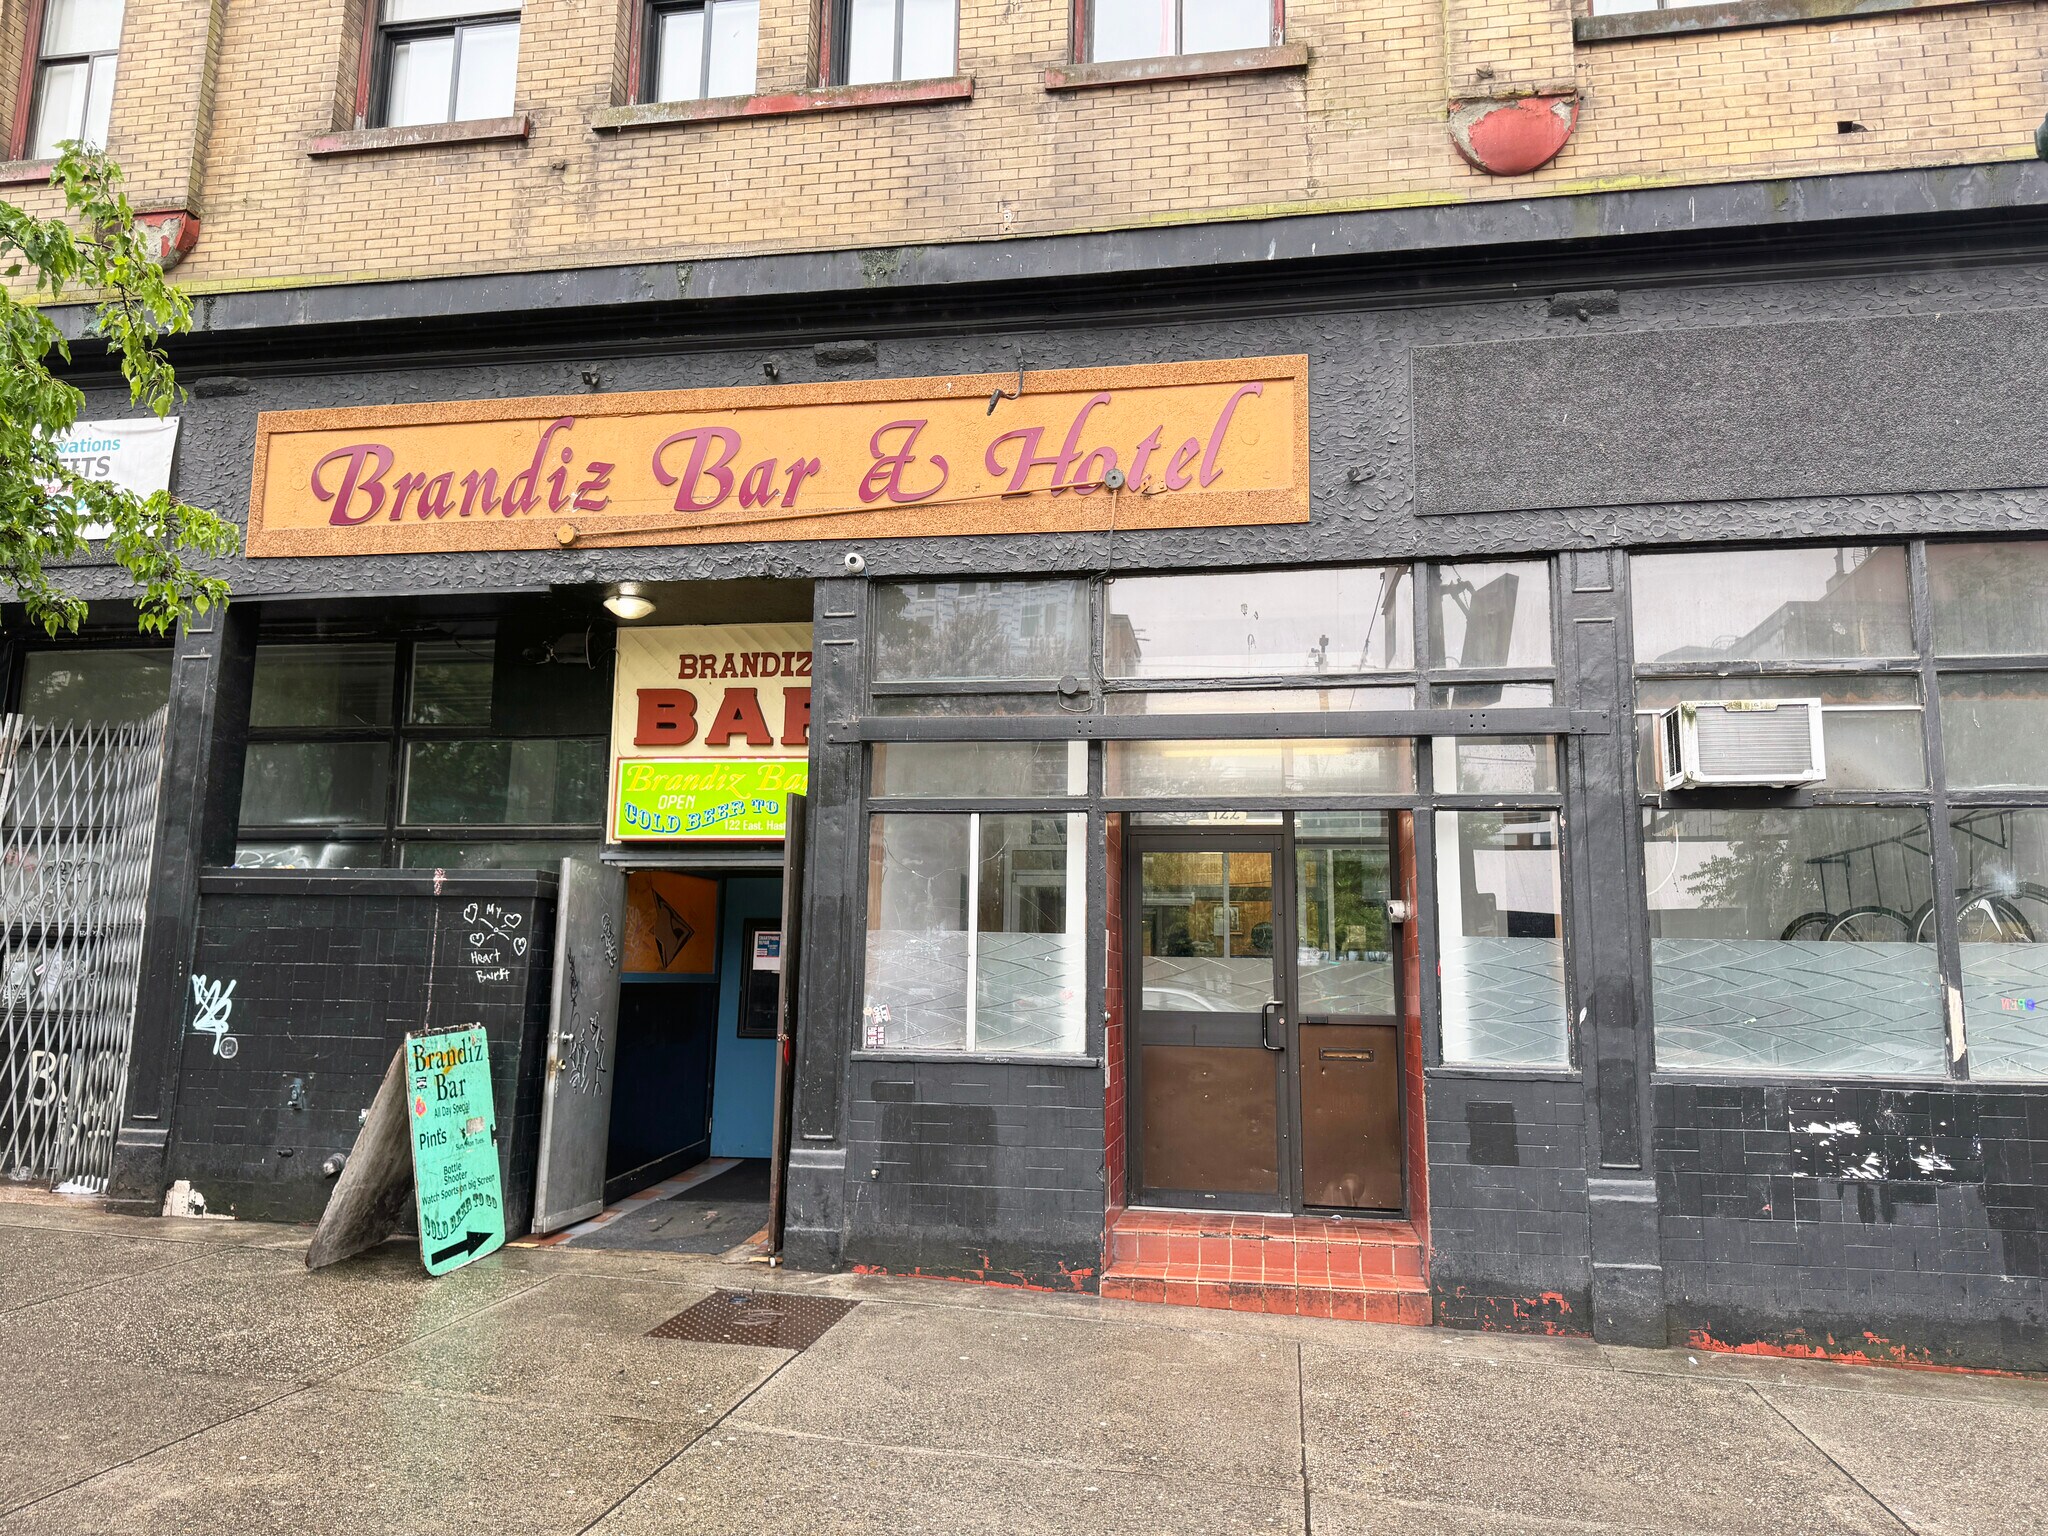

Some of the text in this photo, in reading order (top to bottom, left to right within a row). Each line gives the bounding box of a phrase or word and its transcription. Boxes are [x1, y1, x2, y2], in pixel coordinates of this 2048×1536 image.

[59, 437, 121, 453] vations
[311, 382, 1263, 526] Brandiz Bar & Hotel
[678, 651, 812, 680] BRANDIZ
[626, 764, 751, 799] Brandiz
[658, 795, 696, 810] OPEN
[624, 799, 779, 833] COLD BEER TO
[724, 820, 740, 831] 122
[486, 903, 502, 919] My
[470, 948, 501, 965] Heart
[413, 1036, 484, 1072] Brandiz
[435, 1073, 466, 1101] Bar
[442, 1106, 452, 1117] Day
[443, 1162, 462, 1175] Bottle
[444, 1170, 468, 1186] Shooter
[422, 1193, 440, 1206] Watch
[441, 1186, 460, 1200] Sports
[477, 1174, 495, 1187] Screen
